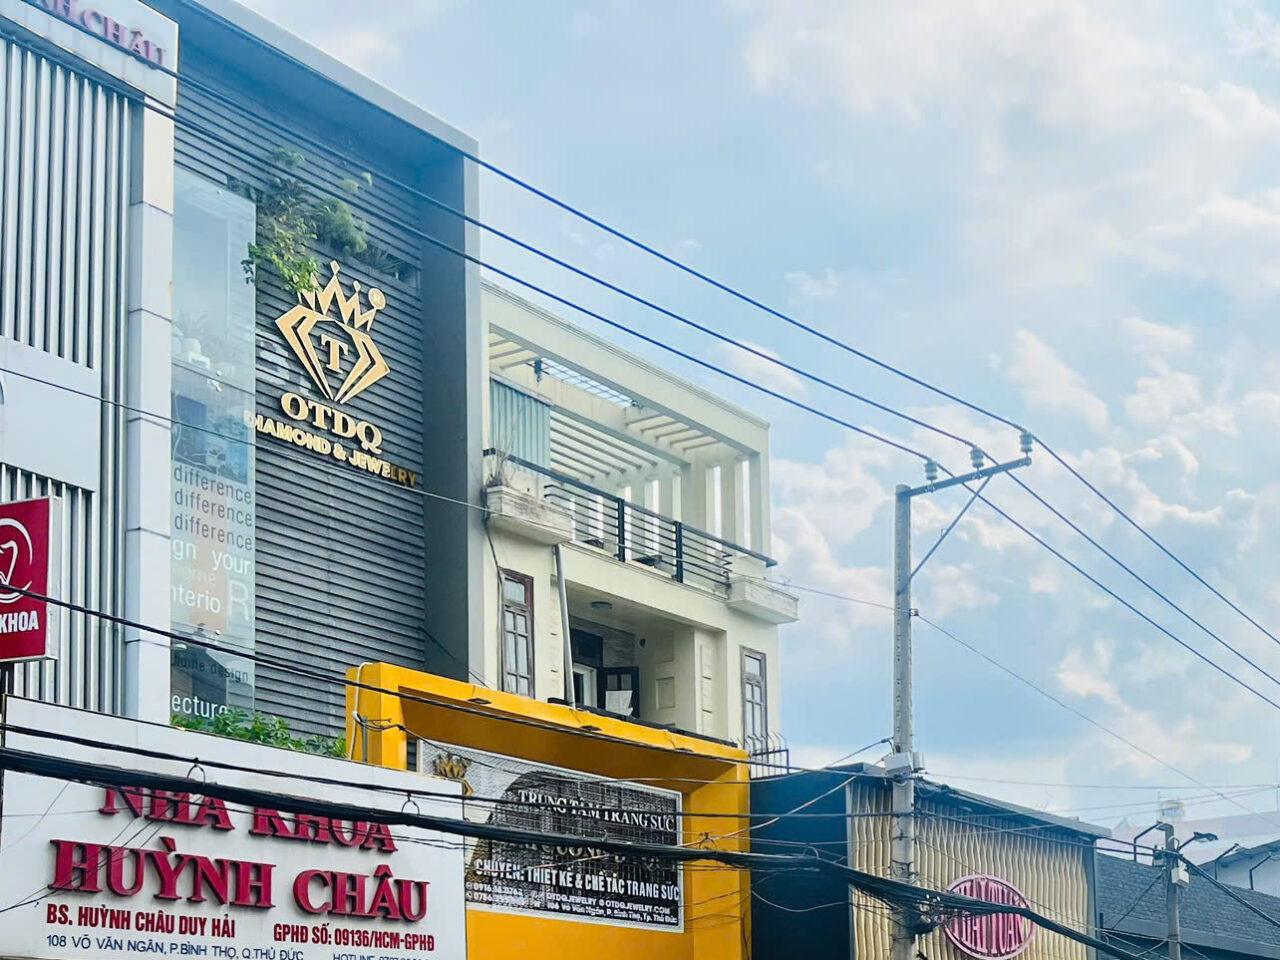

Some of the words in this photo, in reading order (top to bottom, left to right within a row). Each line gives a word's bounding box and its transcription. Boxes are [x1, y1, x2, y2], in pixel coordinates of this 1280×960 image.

[320, 334, 348, 374] T
[281, 392, 382, 454] OTDQ
[244, 410, 331, 455] DIAMOND
[334, 443, 346, 461] &
[349, 450, 417, 487] JEWELRY
[174, 465, 251, 504] difference
[174, 488, 252, 527] difference
[174, 512, 252, 550] difference
[211, 550, 250, 575] your
[210, 663, 248, 684] design
[48, 836, 276, 909] HUỲNH
[293, 864, 429, 923] CHÂU
[575, 874, 583, 889] &
[627, 880, 659, 898] TRANG
[47, 904, 73, 926] BS.
[78, 905, 131, 930] HUỲNH
[135, 910, 175, 934] CHÂU
[179, 916, 207, 937] DUY
[212, 913, 235, 938] HẢI
[273, 923, 309, 943] GPHĐ
[312, 922, 332, 945] SỐ:
[334, 928, 435, 952] 09136/HCM-GPHĐ
[46, 934, 67, 947] 108
[72, 934, 91, 948] VÕ
[96, 937, 123, 950] VĂN
[127, 940, 167, 955] NGÂN,
